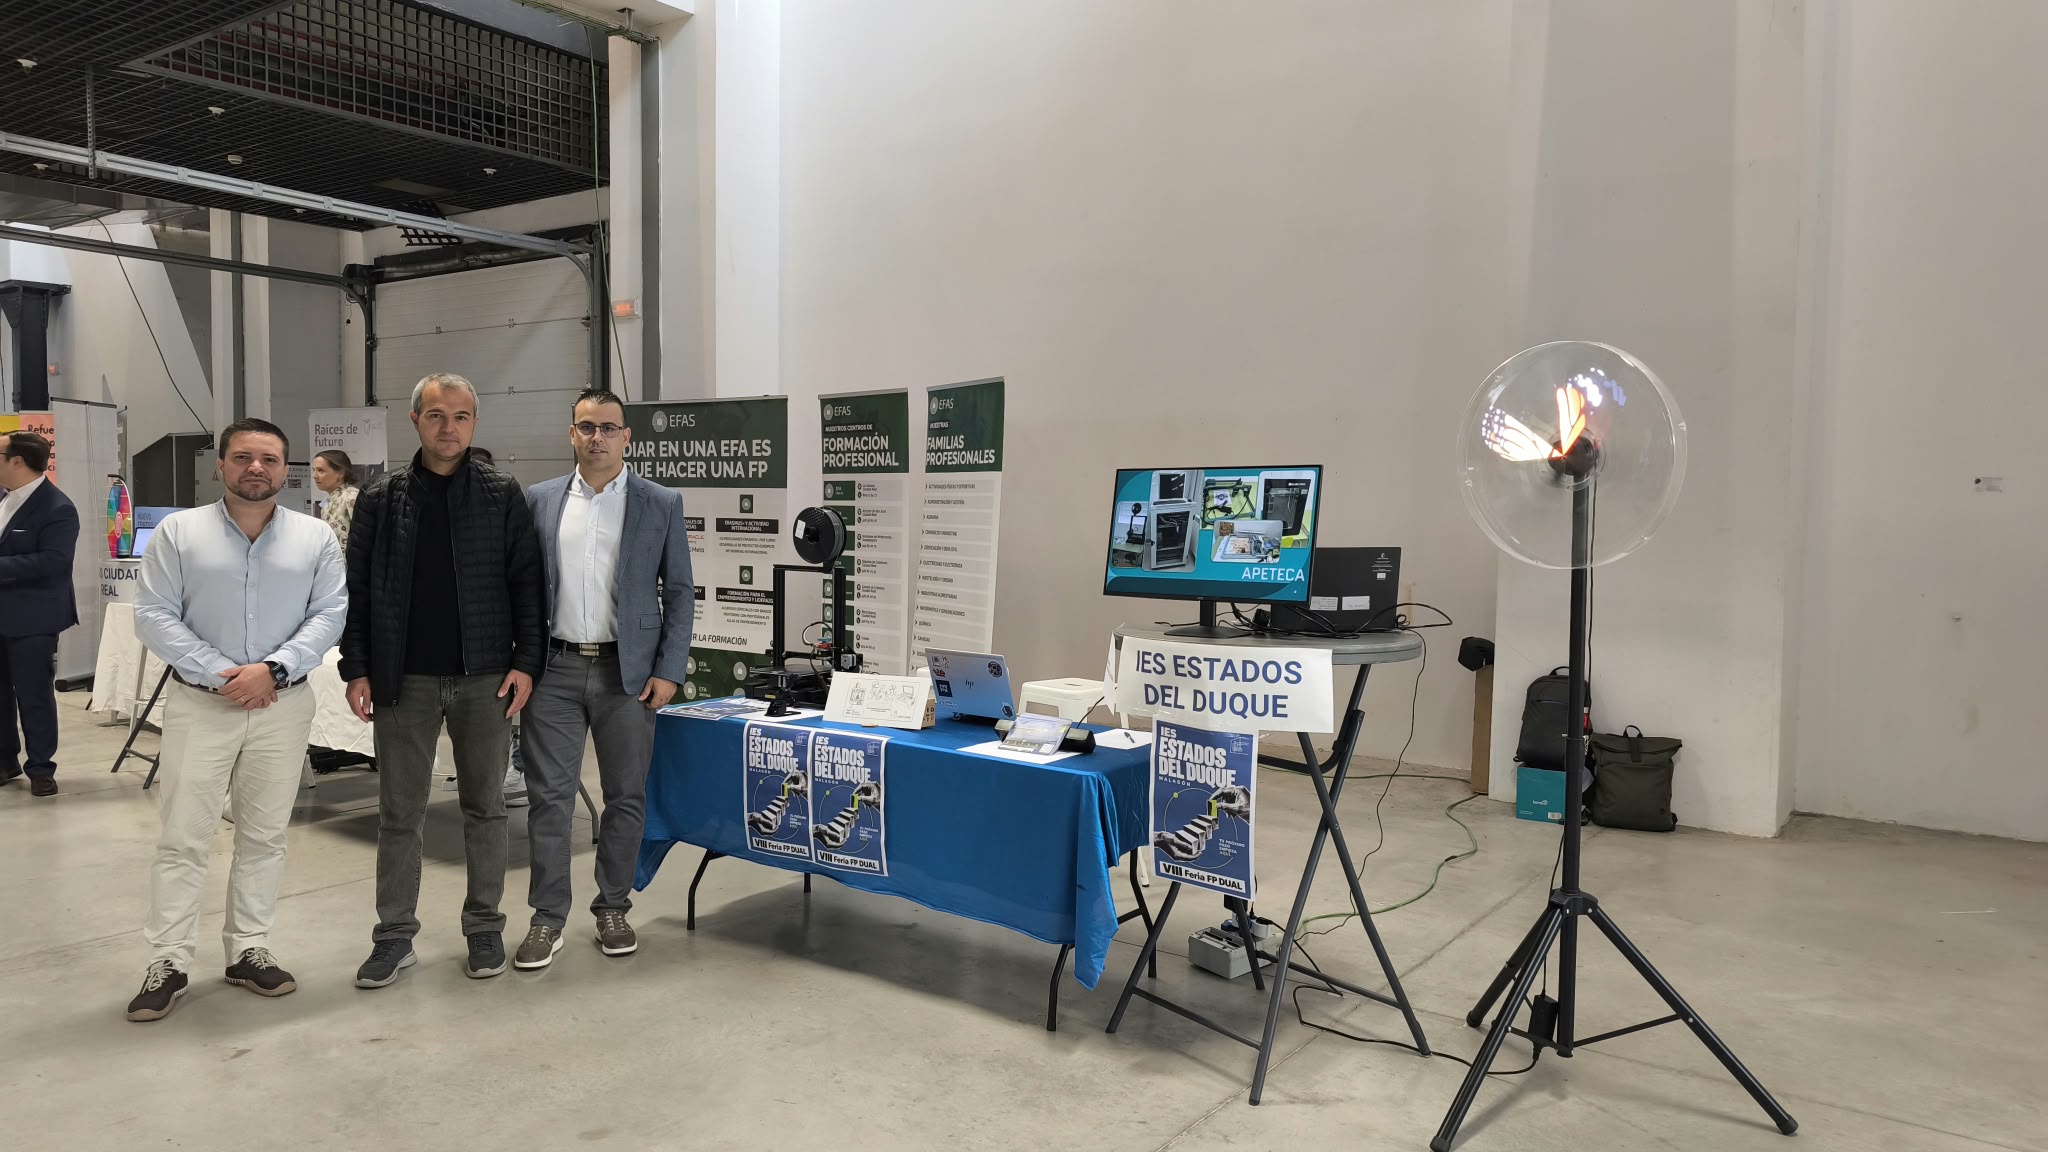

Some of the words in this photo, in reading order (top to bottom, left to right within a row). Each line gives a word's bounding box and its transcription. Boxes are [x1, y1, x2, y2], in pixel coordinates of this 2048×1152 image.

[834, 405, 851, 416] EFAS
[938, 398, 954, 410] EFAS
[314, 423, 344, 435] Raíces
[346, 423, 358, 435] de
[669, 414, 696, 427] EFAS
[315, 436, 344, 447] futuro
[659, 440, 679, 458] EN
[683, 440, 717, 457] UNA
[720, 439, 749, 457] EFA
[752, 439, 772, 457] ES
[823, 431, 889, 452] FORMACIÓN
[927, 434, 965, 450] FAMILIAS
[823, 451, 900, 468] PROFESIONAL
[926, 449, 996, 466] PROFESIONALES
[656, 461, 707, 478] HACER
[711, 461, 745, 478] UNA
[749, 461, 768, 478] FP
[1241, 566, 1305, 582] APETECA
[698, 634, 707, 642] LA
[707, 634, 748, 646] FORMACIÓN
[1136, 650, 1166, 675] IES
[1173, 654, 1303, 685] ESTADOS
[1144, 683, 1185, 710] DEL
[1192, 689, 1289, 720] DUQUE
[749, 727, 762, 736] IES
[815, 735, 829, 745] IES
[1160, 726, 1177, 738] IES
[748, 735, 794, 757] ESTADOS
[1159, 735, 1227, 768] ESTADOS
[749, 751, 766, 769] DEL
[768, 754, 799, 774] DUQUE
[814, 744, 865, 767] ESTADOS
[815, 760, 834, 779] DEL
[835, 762, 871, 785] DUQUE
[1158, 755, 1185, 779] DEL
[1185, 761, 1237, 789] DUQUE
[754, 838, 768, 849] VIII
[768, 842, 782, 851] Feria
[783, 844, 791, 852] FP
[791, 845, 807, 855] DUAL
[819, 851, 833, 863] VIII
[833, 855, 849, 865] Feria
[850, 858, 858, 866] FP
[859, 860, 877, 869] DUAL
[1162, 863, 1183, 877] VIII
[1184, 869, 1205, 882] Feria
[1207, 875, 1218, 884] FP
[1218, 878, 1243, 891] DUAL
